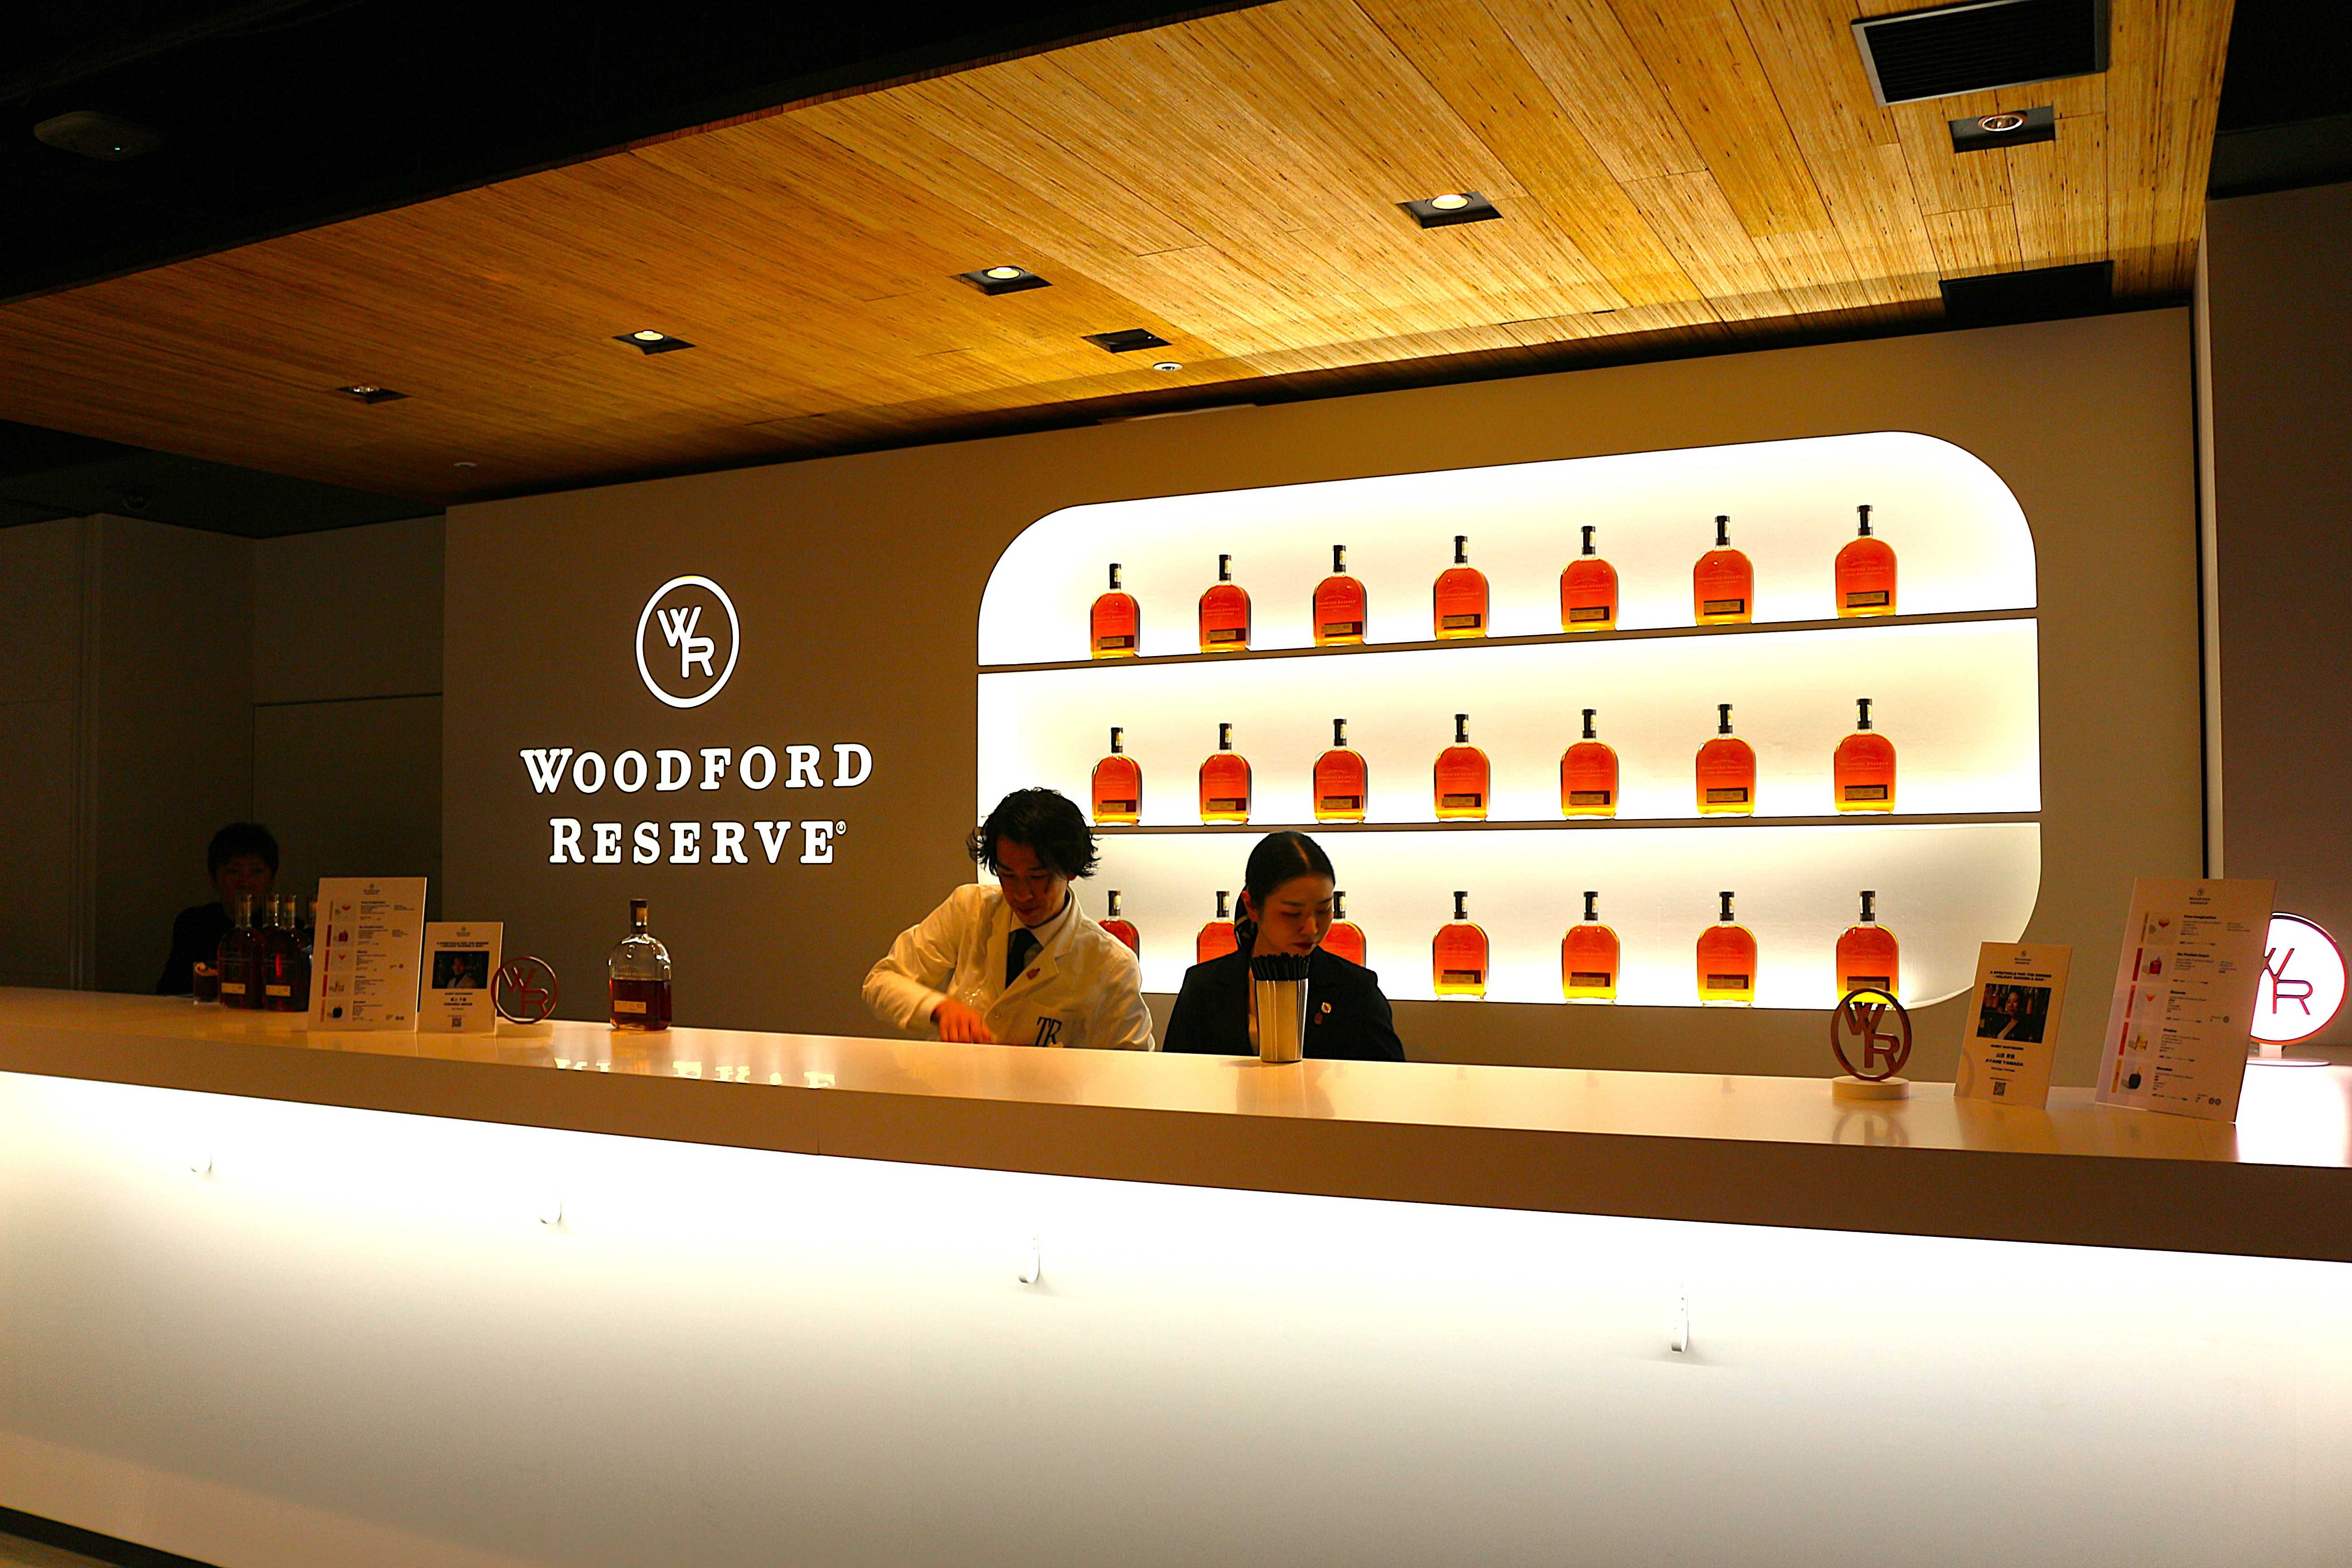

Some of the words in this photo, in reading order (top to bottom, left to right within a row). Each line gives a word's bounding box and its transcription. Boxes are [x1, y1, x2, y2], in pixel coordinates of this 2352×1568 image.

[657, 606, 715, 678] WR
[520, 743, 872, 794] WOODFORD
[1843, 1001, 1900, 1072] WR
